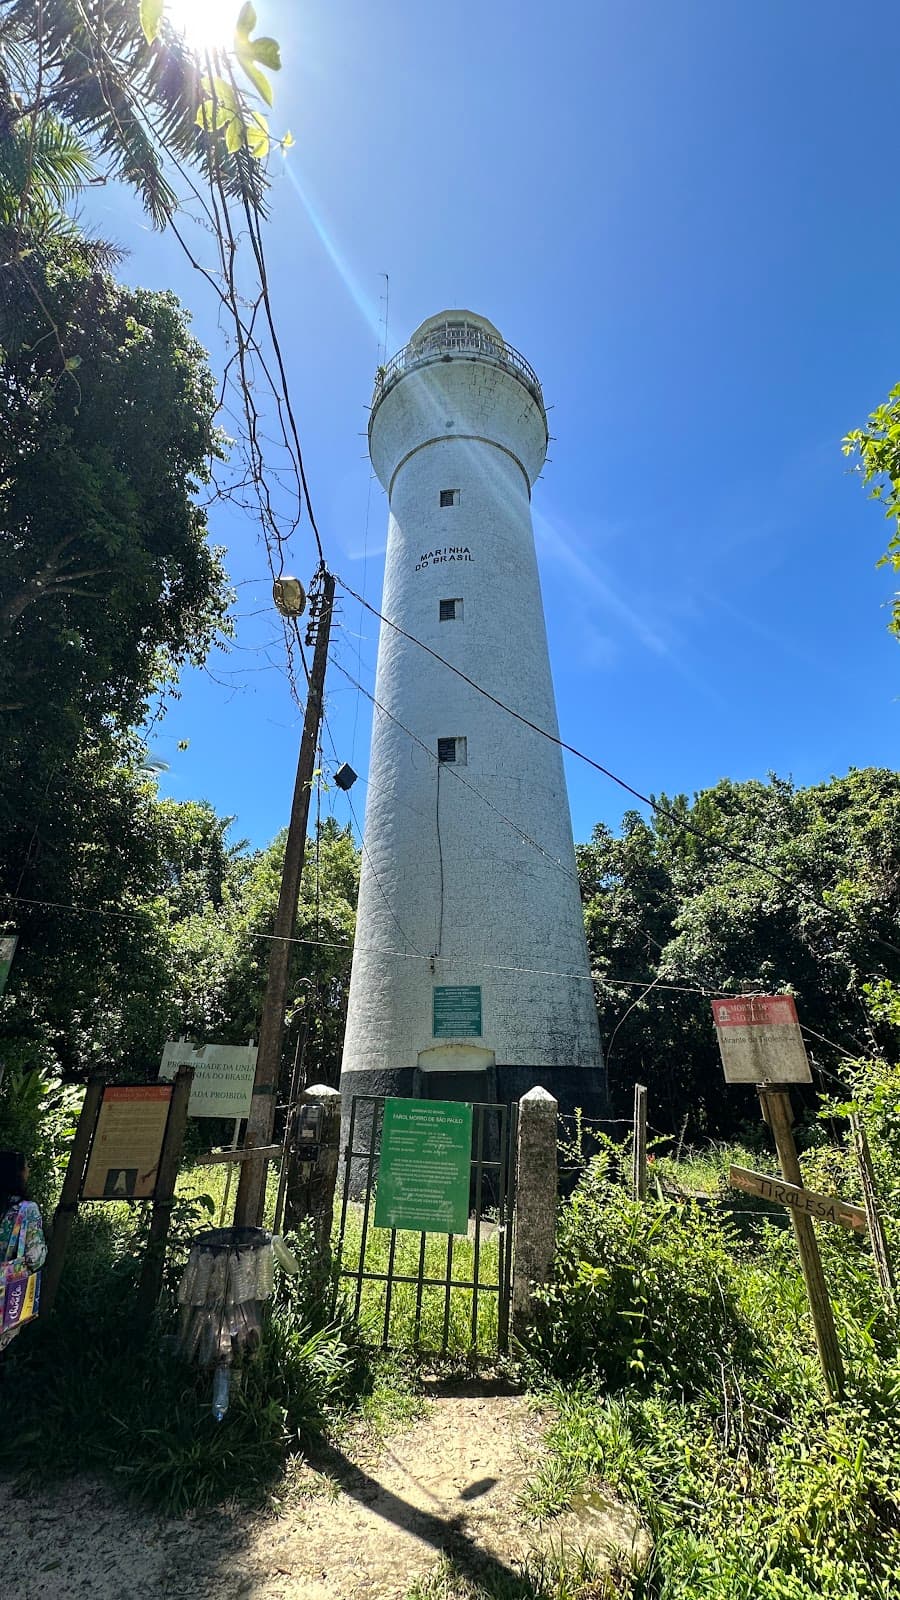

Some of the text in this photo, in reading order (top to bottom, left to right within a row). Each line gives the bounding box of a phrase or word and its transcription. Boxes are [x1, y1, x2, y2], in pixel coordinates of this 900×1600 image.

[420, 547, 471, 561] MARINHA
[415, 555, 475, 572] DO BRASIL
[212, 1072, 224, 1080] DO
[225, 1073, 253, 1081] BRASIL
[210, 1091, 247, 1100] PROIBIDA
[755, 1177, 836, 1220] TIROLESA
